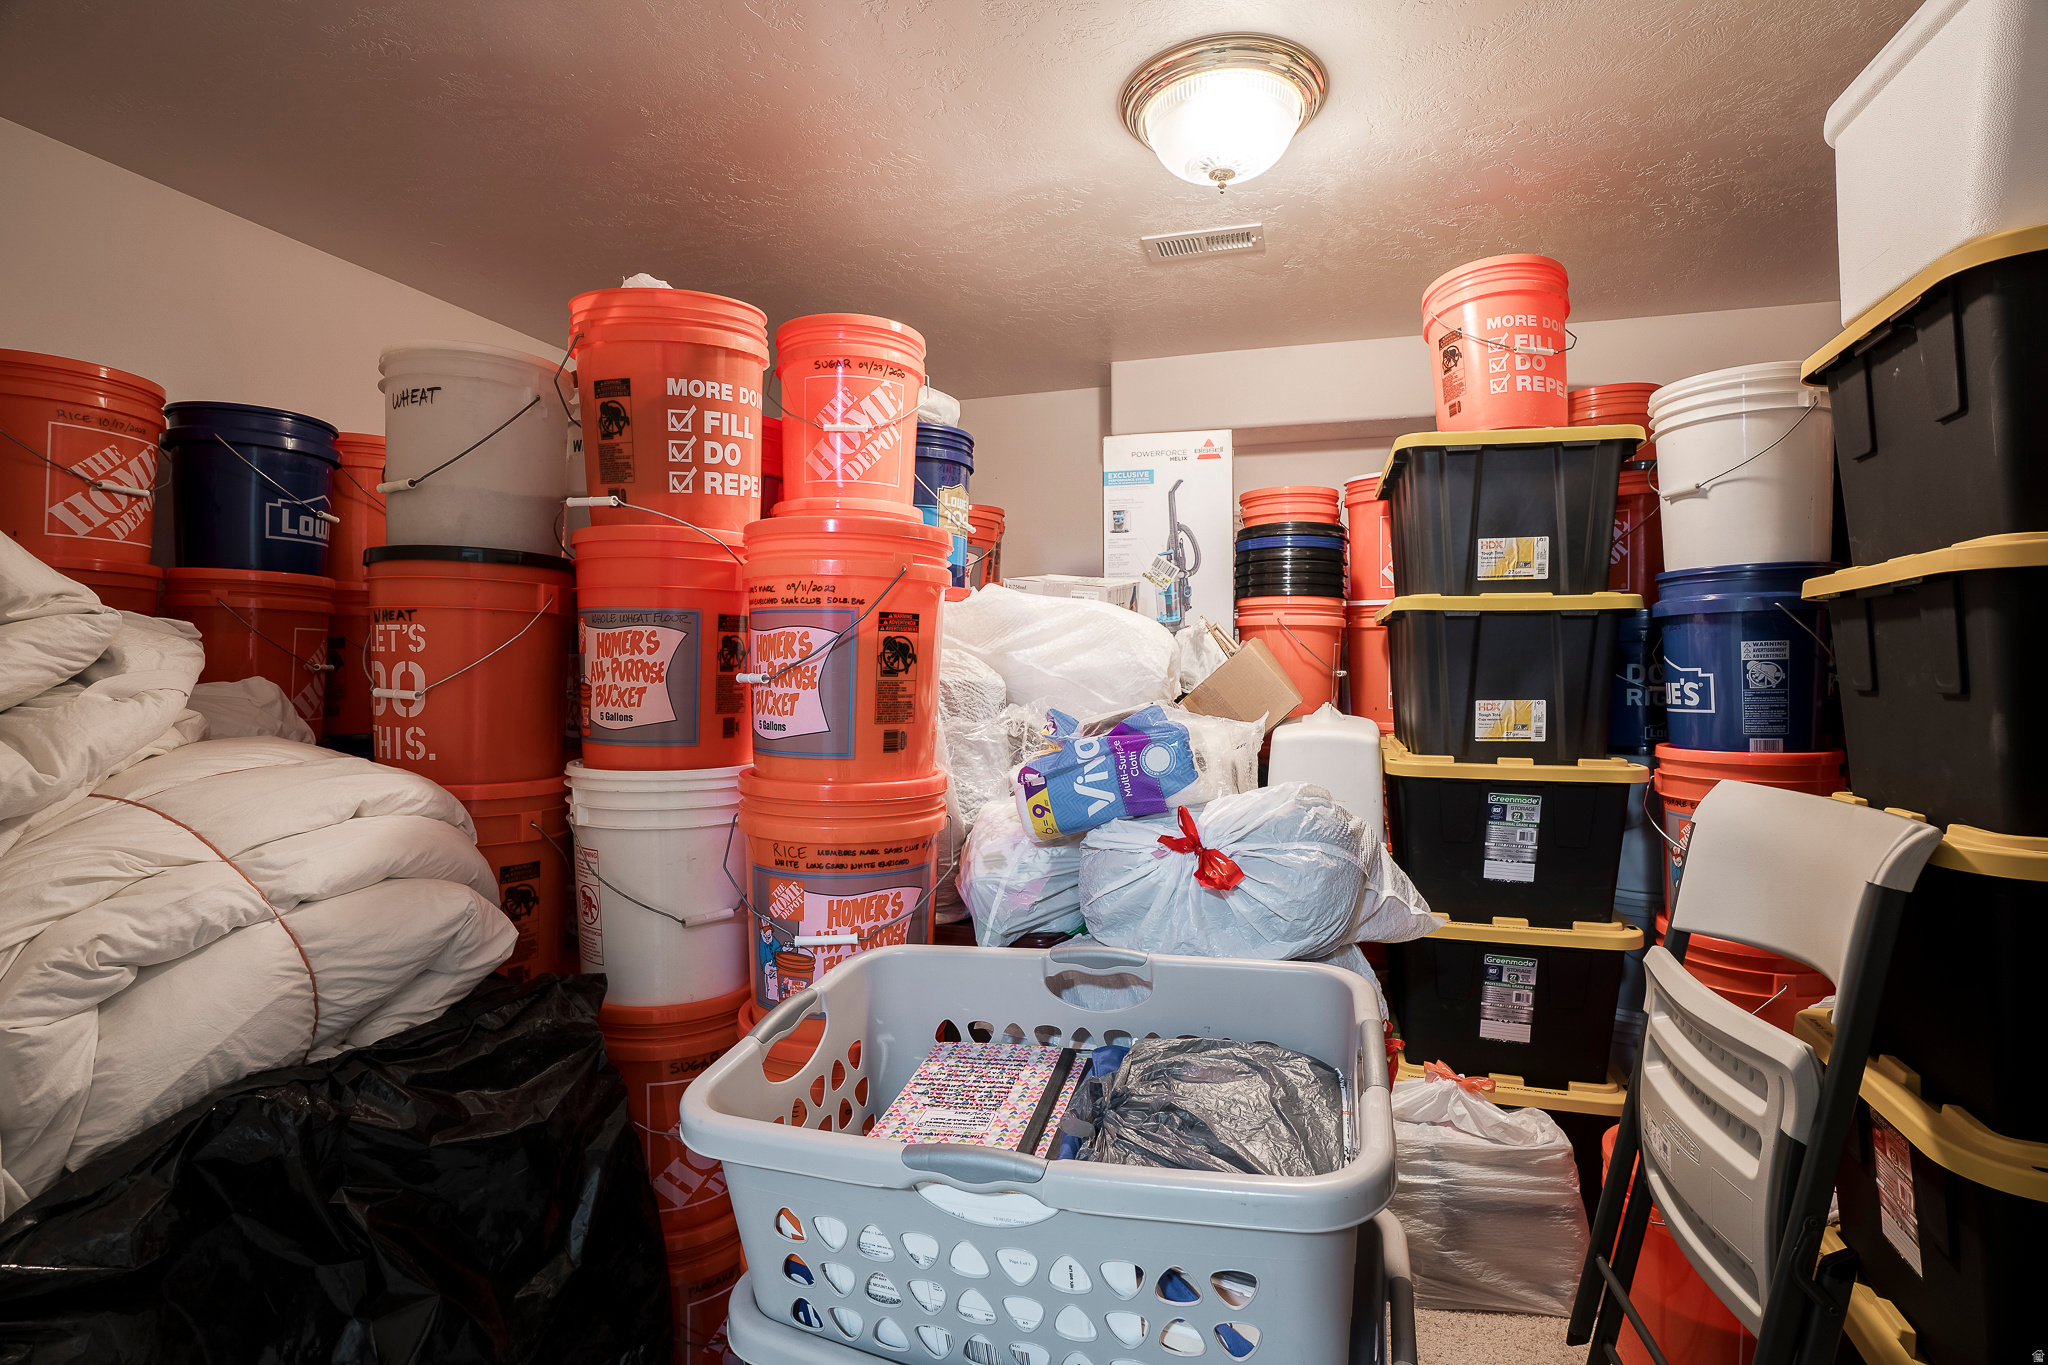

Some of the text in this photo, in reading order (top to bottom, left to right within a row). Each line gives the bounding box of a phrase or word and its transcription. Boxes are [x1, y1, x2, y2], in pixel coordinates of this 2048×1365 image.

[1486, 315, 1537, 330] MORE
[814, 359, 852, 370] SUGAR
[1515, 355, 1546, 371] DO
[392, 387, 442, 410] WHEAT
[666, 377, 733, 402] MORE
[56, 409, 92, 423] RICE
[813, 386, 859, 425] THE
[704, 410, 754, 440] FILL
[805, 380, 903, 481] HOME
[67, 444, 127, 480] THE
[704, 440, 742, 467] DO
[842, 421, 901, 480] DEPOT
[1131, 449, 1187, 458] POWERFORCE
[1108, 471, 1149, 479] EXCLUSIVE
[282, 508, 330, 541] LOW
[1481, 541, 1503, 549] HDX
[373, 608, 418, 623] WHEAT
[591, 613, 691, 625] WHOLE WHEAT FLOUR
[596, 630, 661, 659] HOMER'S
[756, 631, 813, 664] HOMER'S
[591, 658, 665, 685] ALL-PURPOSE
[371, 660, 426, 718] DO
[595, 684, 648, 709] BUCKET
[756, 689, 800, 717] BUCKET
[1478, 703, 1501, 711] HDX
[600, 712, 634, 722] 5 Gallons
[759, 720, 787, 732] 5 Gallons
[1114, 740, 1133, 797] Multi-Surface
[1129, 751, 1139, 777] Cloth
[1490, 795, 1537, 804] Greenmade
[772, 843, 808, 859] RICE
[904, 844, 919, 853] CLUB
[774, 859, 800, 868] WHITE
[851, 862, 875, 870] WHITE
[769, 881, 805, 919] HOME
[771, 882, 787, 898] THE
[780, 895, 805, 920] DEPOT
[827, 891, 904, 929] HOMER'S
[1487, 957, 1534, 966] Greenmade
[689, 1270, 735, 1298] PANCAKE
